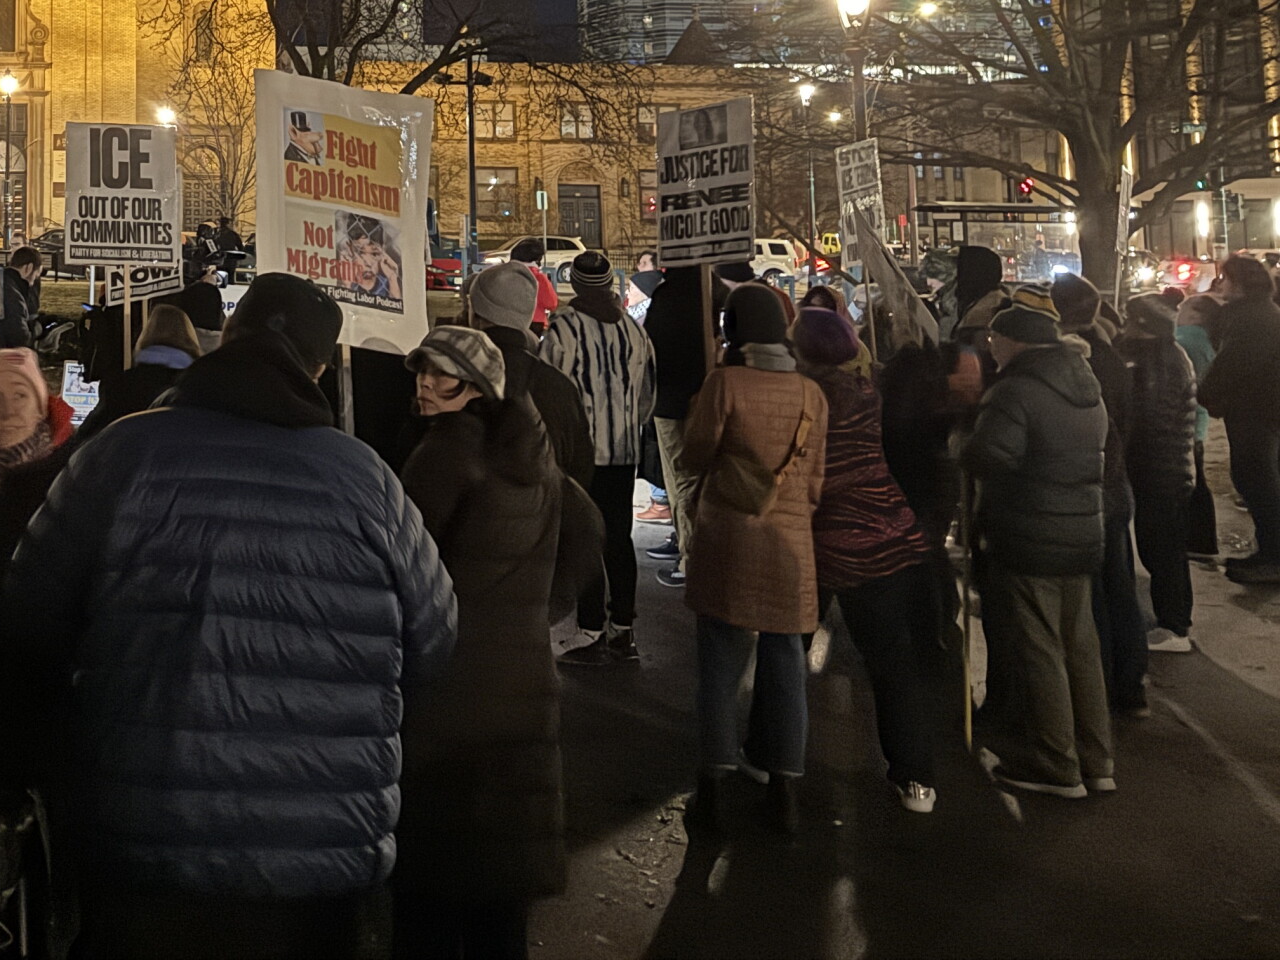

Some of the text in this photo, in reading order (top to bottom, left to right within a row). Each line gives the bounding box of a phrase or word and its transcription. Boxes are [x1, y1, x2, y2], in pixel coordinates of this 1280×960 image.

[89, 127, 153, 189] ICE
[326, 130, 377, 170] Fight
[660, 144, 750, 184] JUSTICE FOR
[285, 163, 400, 212] Capitalism
[661, 183, 750, 212] RENEE
[78, 195, 162, 221] OUT OF OUR
[660, 205, 750, 240] NICOLE GOOD
[70, 219, 173, 245] COMMUNITIES
[304, 220, 334, 249] Not
[131, 249, 139, 258] &
[327, 286, 402, 309] Fighting Labor Podcast
